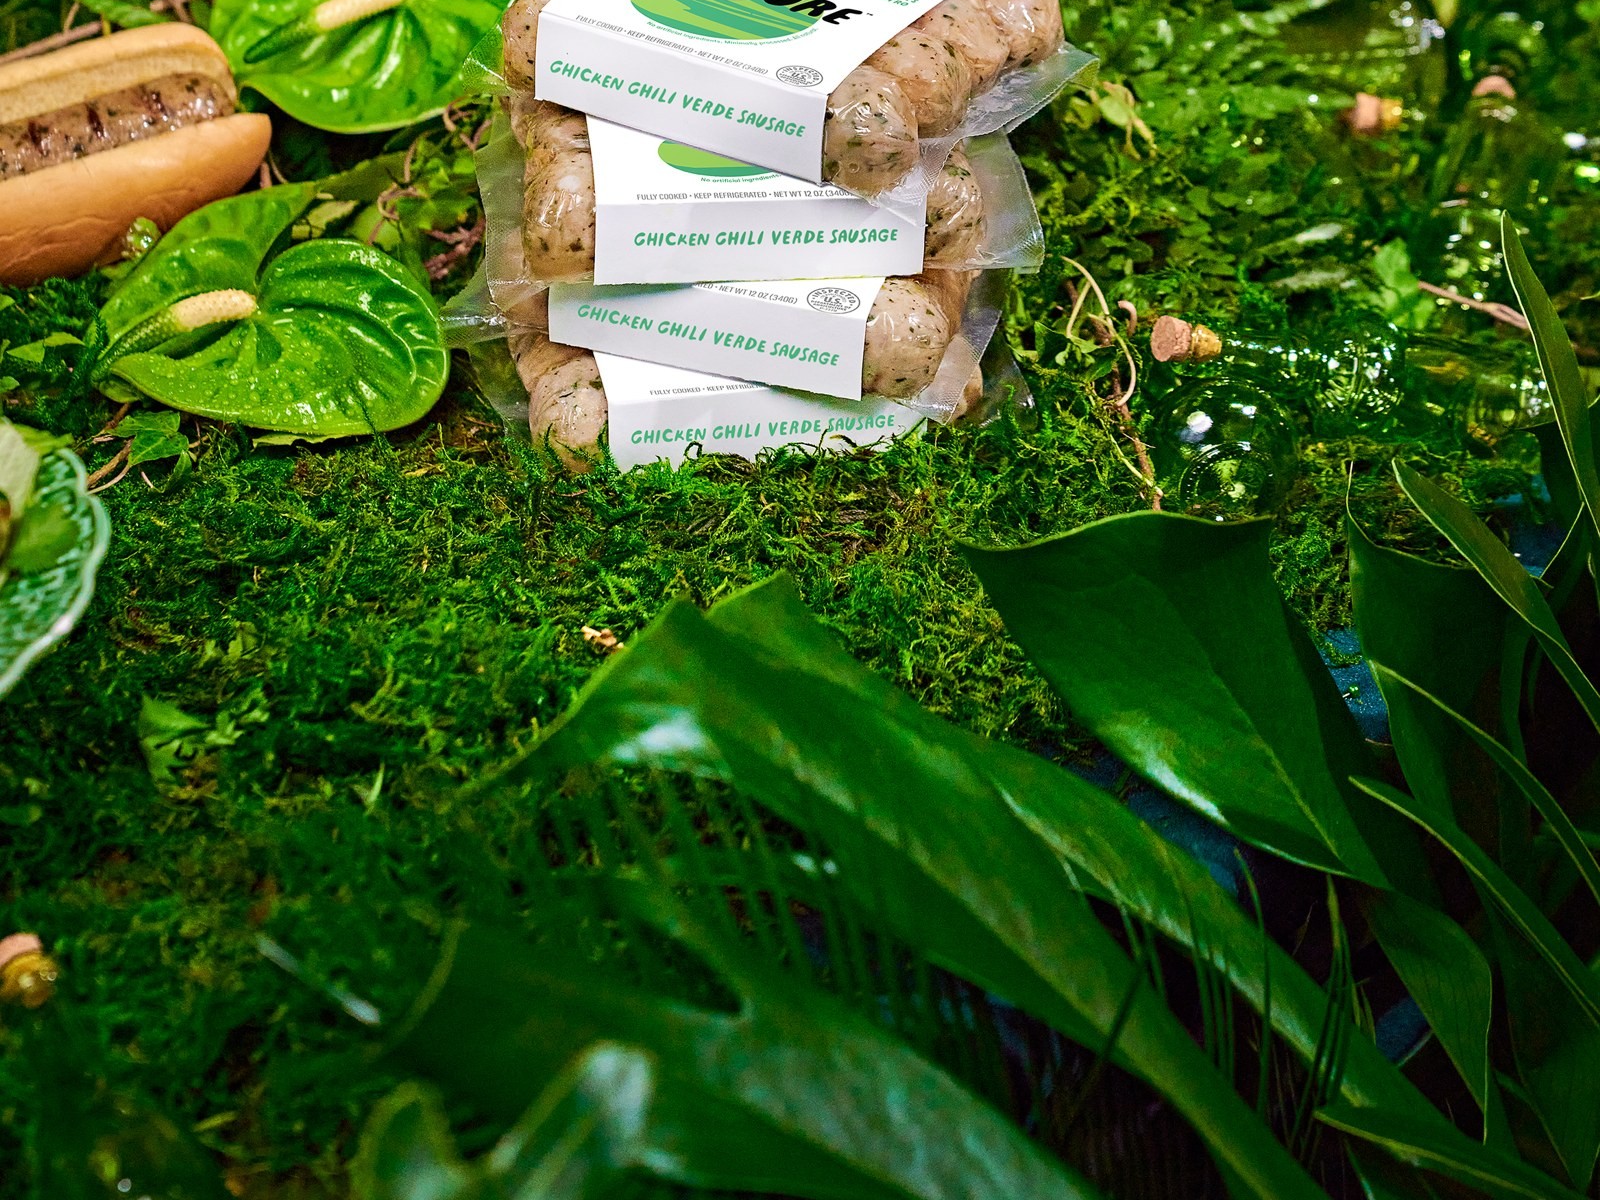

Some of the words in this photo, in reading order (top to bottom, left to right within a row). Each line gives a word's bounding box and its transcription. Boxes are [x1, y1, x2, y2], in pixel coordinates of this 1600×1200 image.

[575, 14, 596, 25] FULLY
[596, 20, 623, 33] COOKED
[627, 29, 646, 39] KEEP
[645, 34, 694, 54] REFRIGERATED
[697, 50, 712, 59] NET
[712, 54, 725, 62] WT
[549, 60, 624, 91] CHICKEN
[627, 81, 677, 104] CHILI
[682, 94, 735, 119] VERDE
[737, 109, 806, 138] SAUSAGE
[713, 191, 767, 199] REFRIGERATED
[634, 231, 710, 247] CHICKEN
[715, 230, 764, 246] CHILI
[771, 229, 824, 245] VERDE
[829, 228, 898, 244] SAUSAGE
[718, 284, 735, 293] NET
[734, 287, 748, 296] WT
[748, 289, 757, 298] 12
[757, 291, 769, 300] OZ
[769, 293, 798, 305] (340G)
[577, 304, 653, 331] CHICKEN
[657, 320, 708, 341] CHILI
[713, 332, 767, 353] VERDE
[770, 341, 840, 366] SAUSAGE
[649, 388, 671, 396] FULLY
[630, 427, 707, 445] CHICKEN
[712, 422, 761, 441] CHILI
[768, 417, 822, 438] VERDE
[828, 414, 896, 433] SAUSAGE
